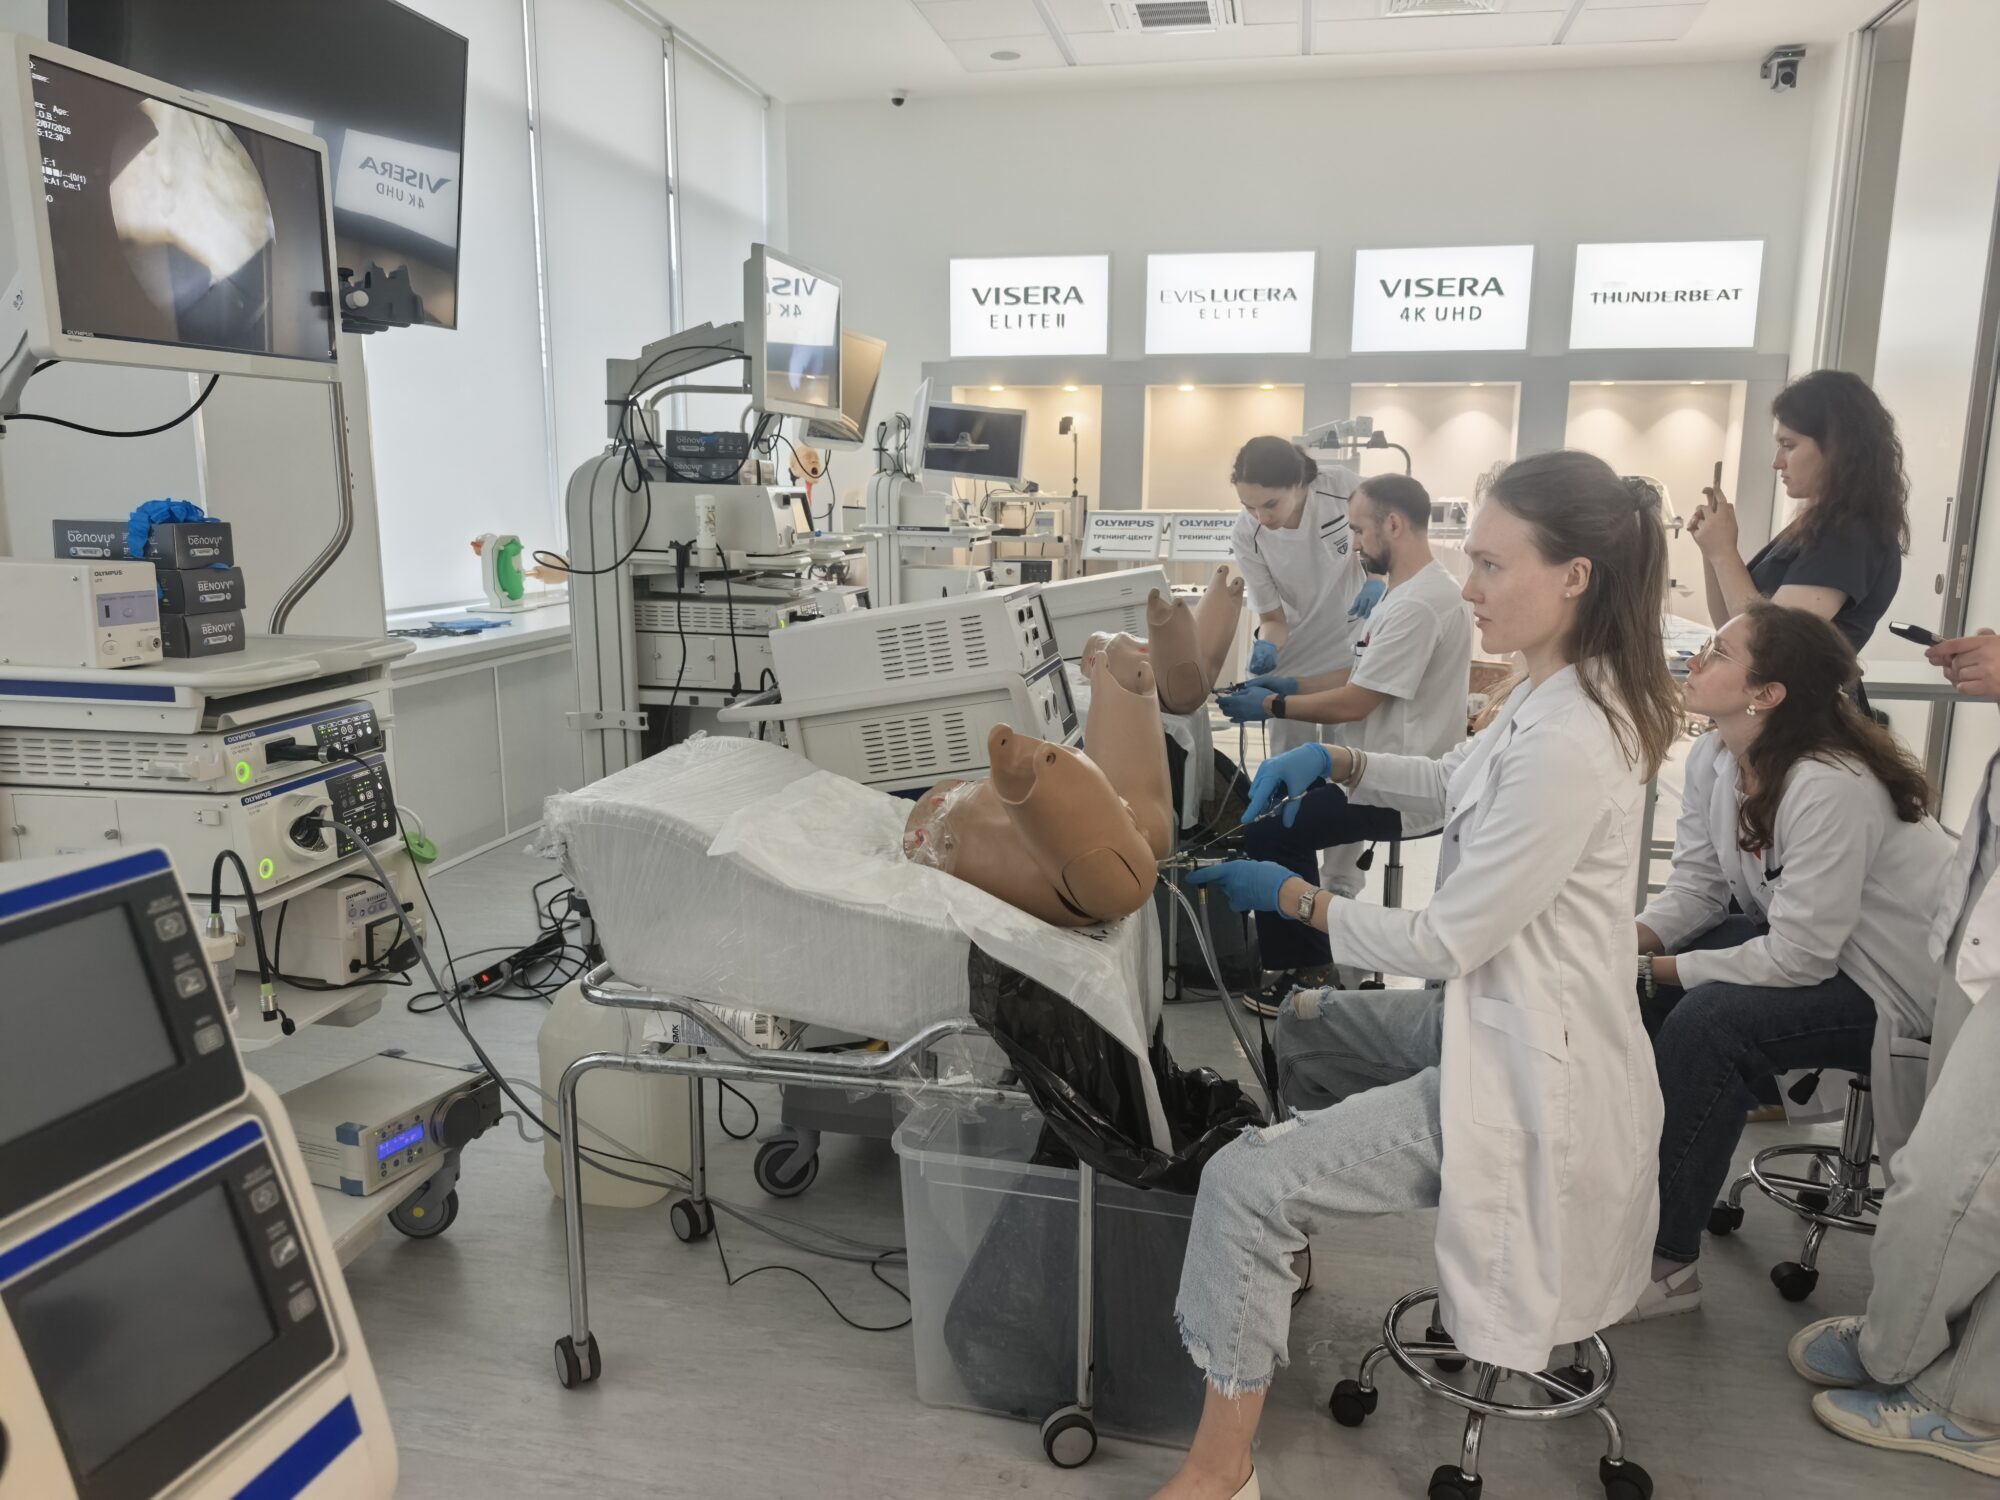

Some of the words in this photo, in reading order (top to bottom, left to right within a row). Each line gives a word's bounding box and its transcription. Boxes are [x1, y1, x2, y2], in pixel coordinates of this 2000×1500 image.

[36, 127, 64, 141] 5:12:30
[1380, 277, 1504, 298] VISERA
[972, 286, 1084, 306] VISERA
[1210, 287, 1297, 303] LUCERA
[1591, 287, 1743, 305] THUNDERBEAT
[1199, 307, 1259, 320] ELITE
[1400, 306, 1426, 322] 4K
[1435, 305, 1482, 322] UHD
[1095, 519, 1155, 528] OLYMPUS
[1179, 519, 1236, 528] OLYMPU
[1093, 533, 1153, 541] ТРЕНИНГ-ЦЕНТР
[94, 569, 124, 577] OLYMPUS
[227, 731, 256, 743] OLYMPUS
[244, 790, 272, 804] OLYMPUS
